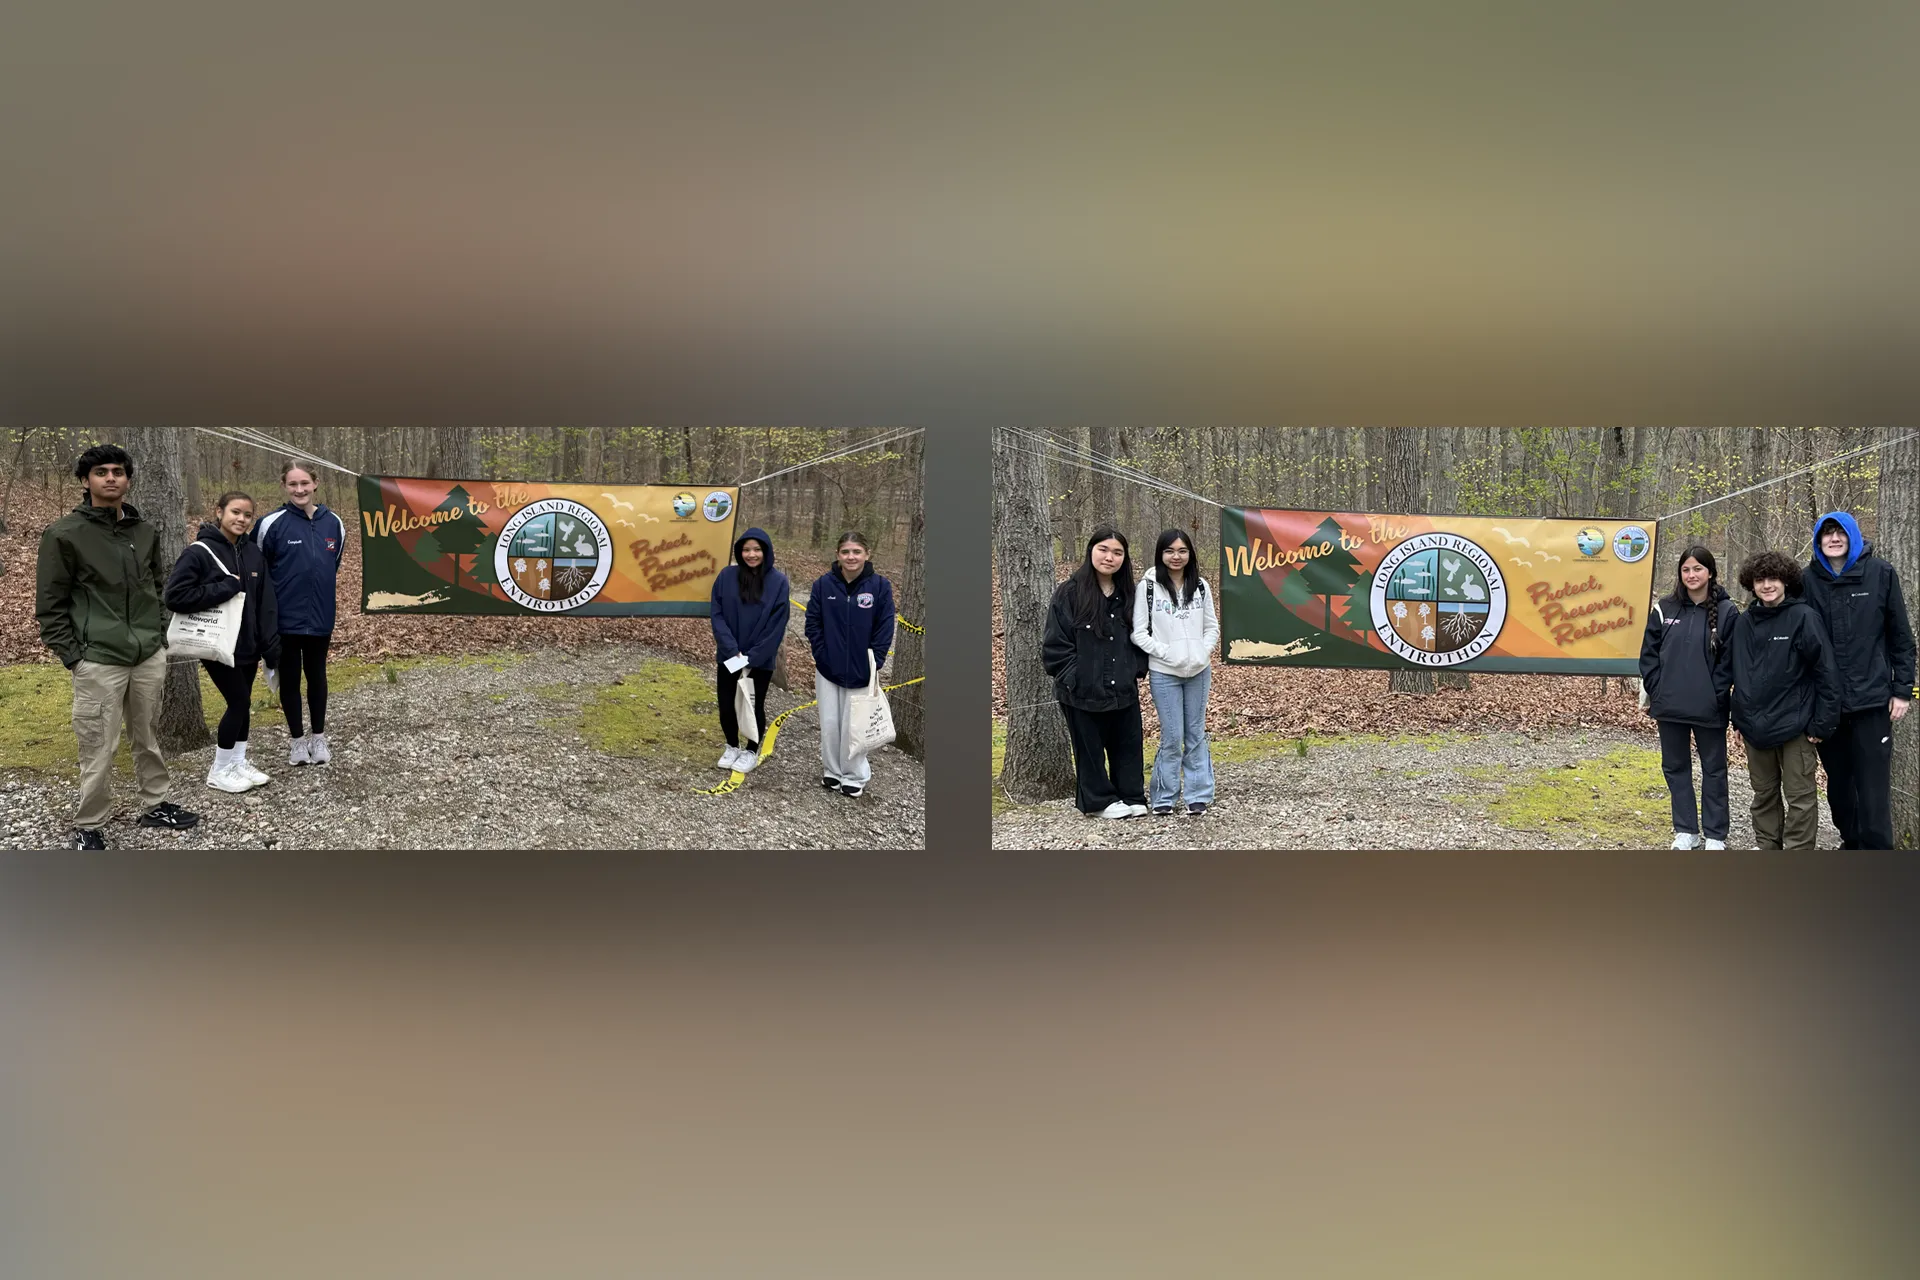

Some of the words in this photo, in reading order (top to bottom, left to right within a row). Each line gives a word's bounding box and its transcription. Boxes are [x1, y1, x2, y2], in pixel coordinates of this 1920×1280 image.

[363, 504, 463, 538] Welcome
[467, 496, 490, 516] to
[493, 484, 529, 509] the
[500, 518, 522, 549] LONG
[521, 501, 564, 520] ISLAND
[567, 504, 608, 551] REGIONAL
[629, 533, 693, 559] Protect,
[638, 549, 712, 577] Preserve,
[1225, 538, 1334, 577] Welcome
[1338, 529, 1364, 551] to
[1368, 517, 1410, 544] the
[647, 558, 716, 592] Restore!
[1376, 555, 1400, 590] LONG
[1400, 536, 1448, 557] ISLAND
[1452, 540, 1501, 595] REGIONAL
[500, 577, 601, 611] ENVIROTHON
[1526, 575, 1603, 605] Protect,
[188, 614, 219, 624] Reworld
[1538, 595, 1628, 626] Preserve,
[1550, 605, 1634, 646] Restore!
[1377, 622, 1495, 664] ENVIROTHON
